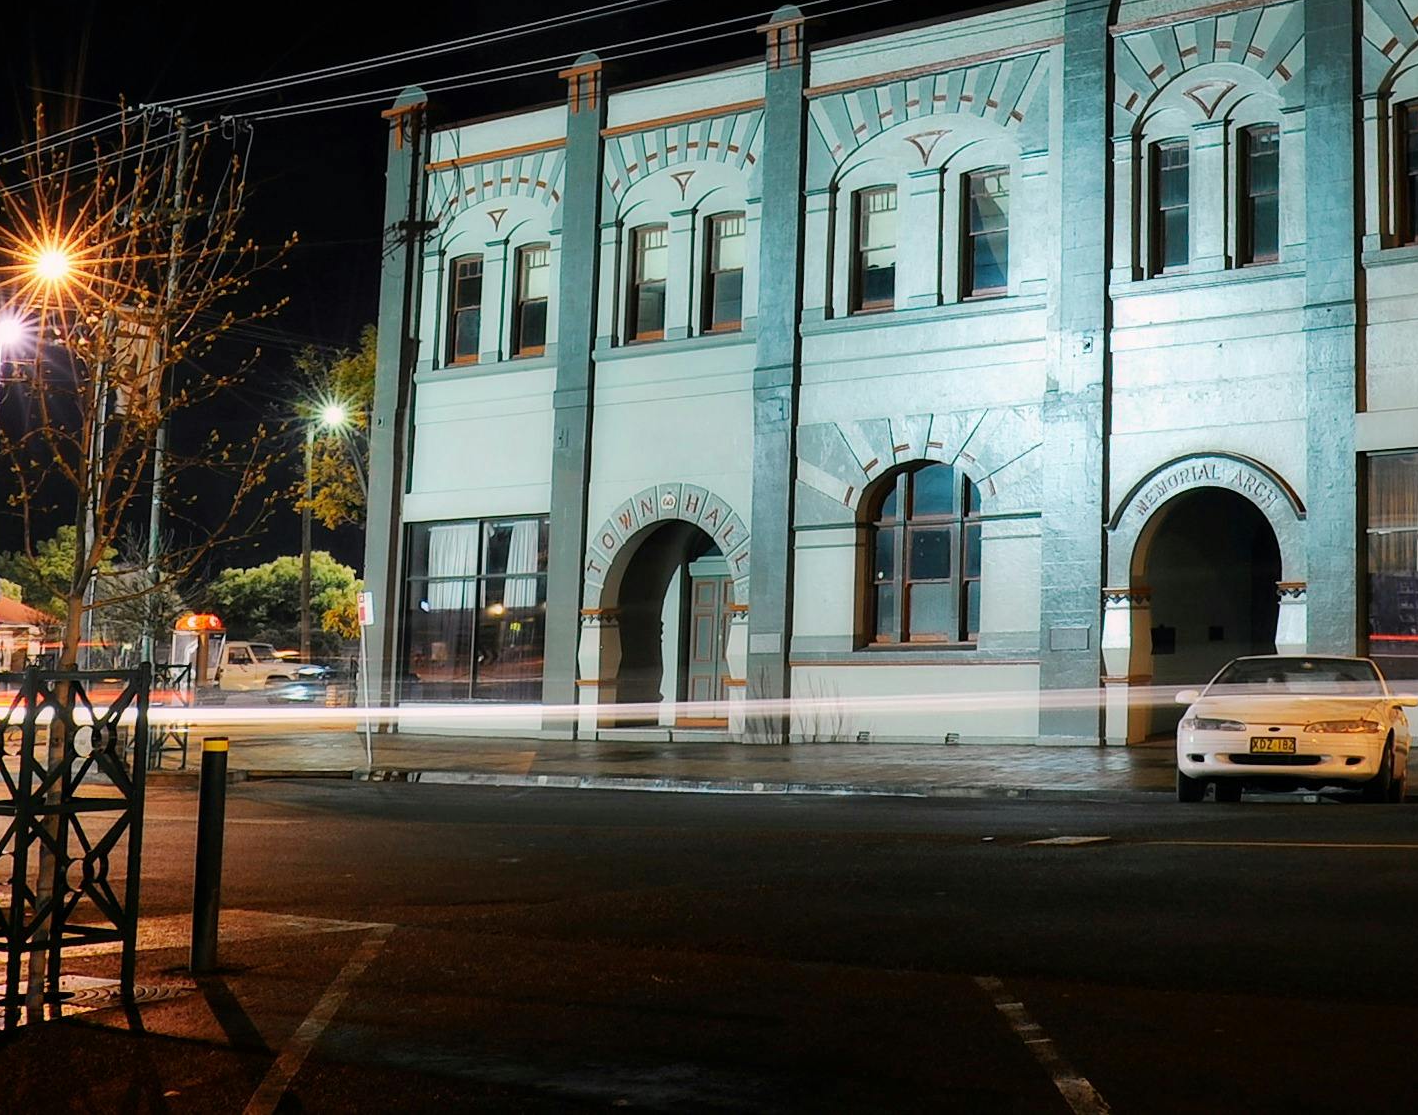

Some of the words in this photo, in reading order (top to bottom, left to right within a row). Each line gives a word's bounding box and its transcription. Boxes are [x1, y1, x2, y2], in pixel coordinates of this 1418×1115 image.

[1135, 464, 1221, 517] MEMORIAL
[1232, 469, 1279, 509] ARCH
[586, 497, 654, 574] TOWN
[685, 493, 749, 572] HALL
